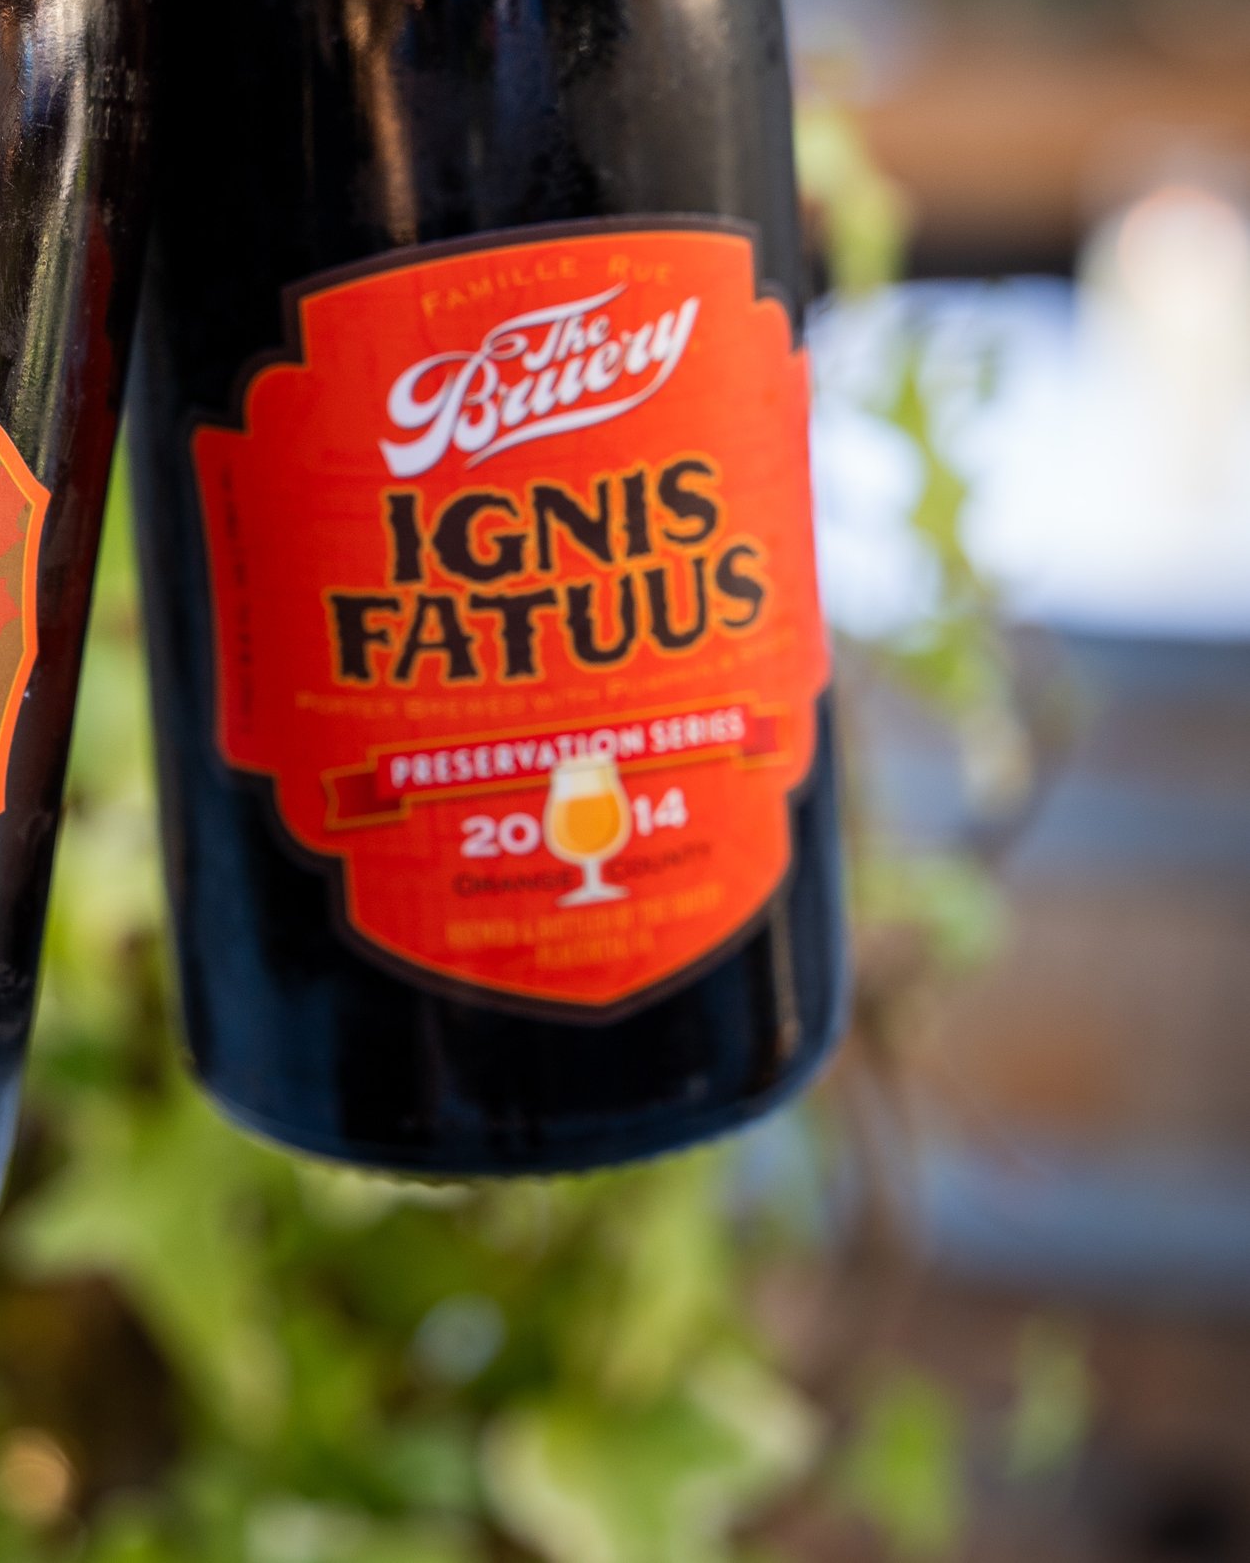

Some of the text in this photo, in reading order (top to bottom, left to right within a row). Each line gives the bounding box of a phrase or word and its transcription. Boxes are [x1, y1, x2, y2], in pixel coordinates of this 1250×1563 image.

[420, 254, 673, 319] FAMILLE RUE
[378, 296, 701, 478] Bruery
[382, 454, 722, 587] IGNIS
[326, 541, 768, 685] FATUUS
[390, 704, 746, 788] PRESERVATION SERIES
